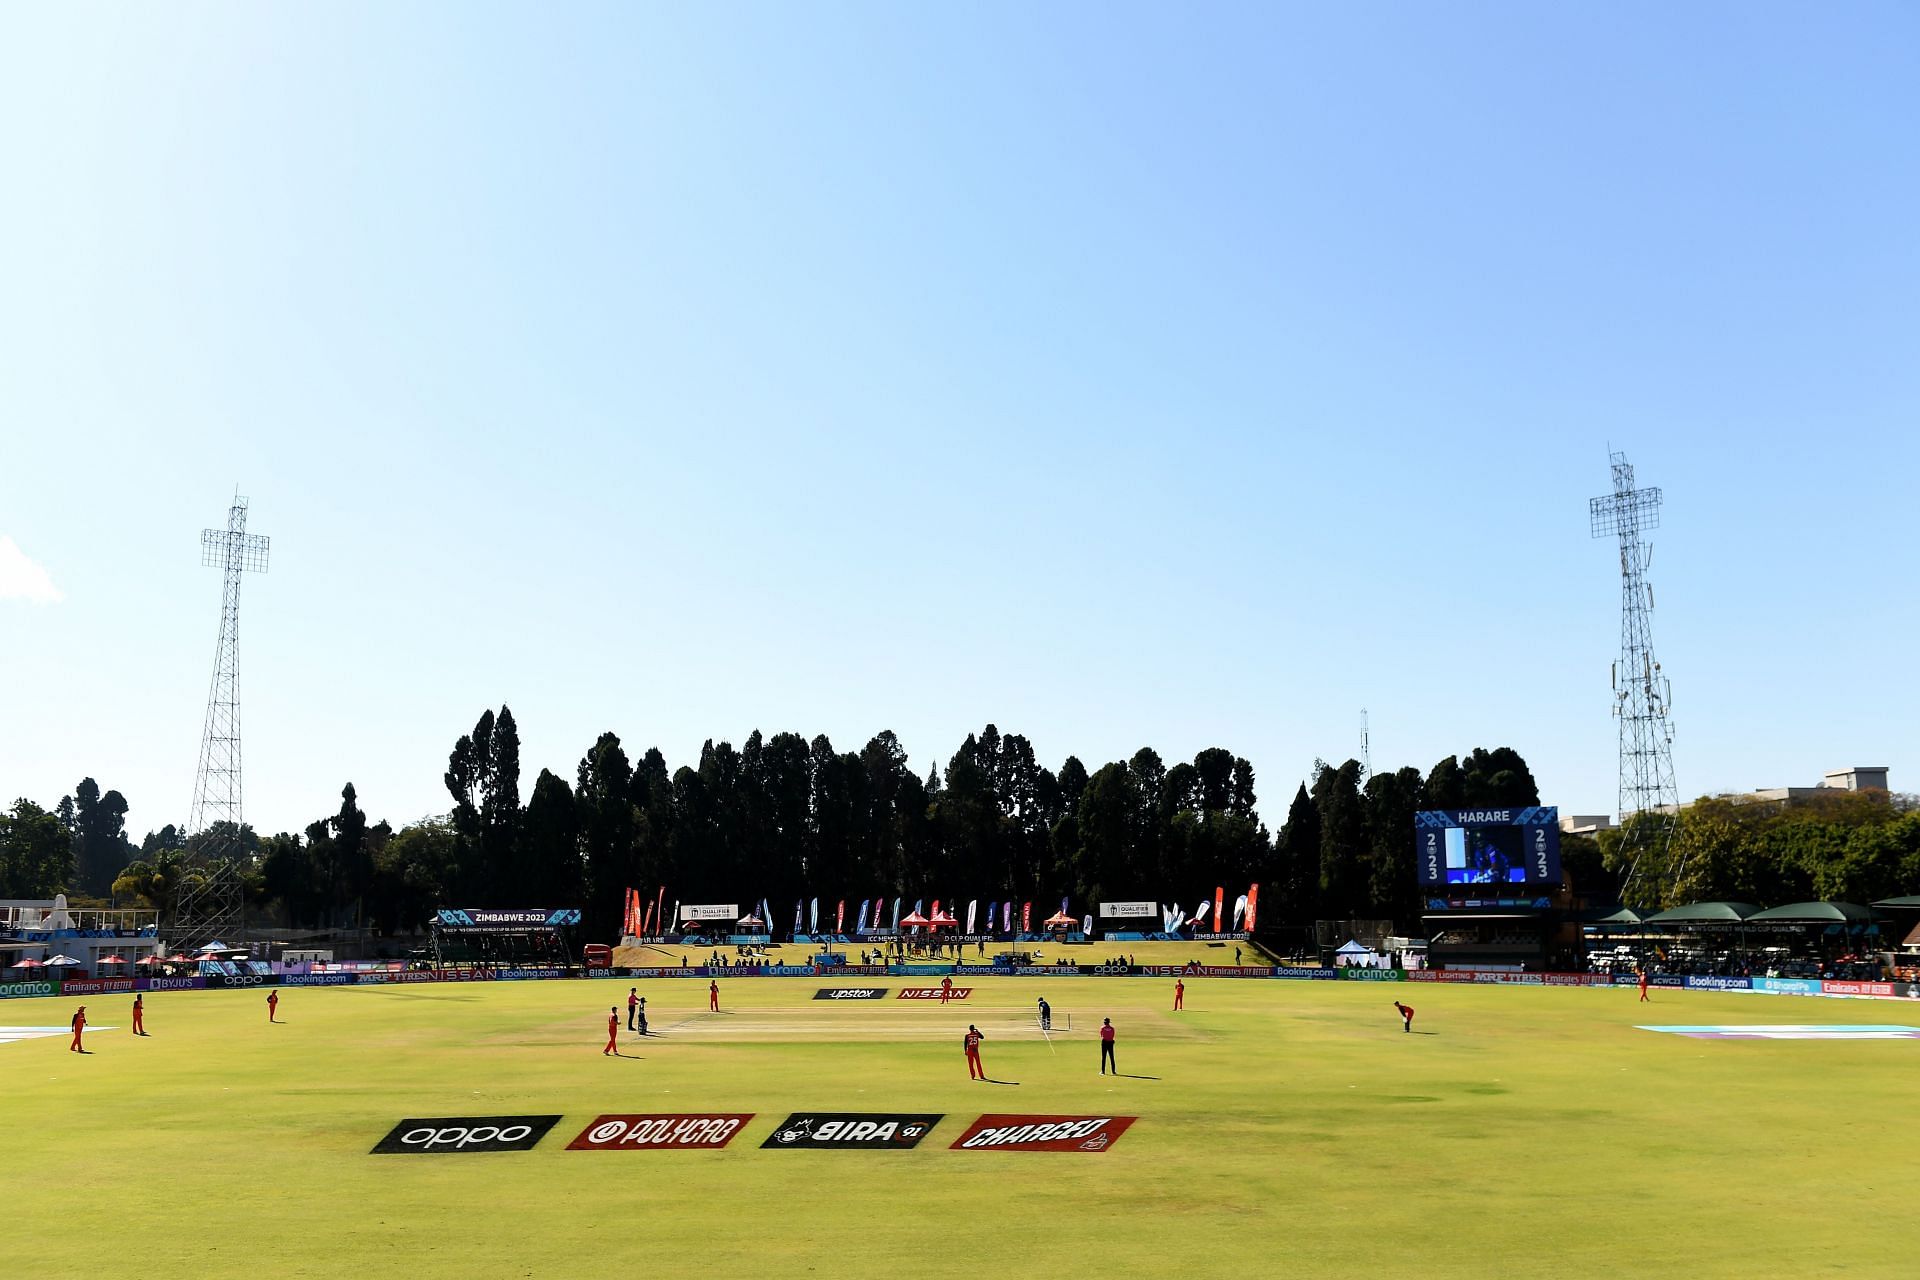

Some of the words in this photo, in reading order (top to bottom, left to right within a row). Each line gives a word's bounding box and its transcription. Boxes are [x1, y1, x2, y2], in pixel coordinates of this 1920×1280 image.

[1458, 811, 1510, 823] HARARE
[476, 914, 524, 922] ZIMBABWE
[525, 913, 546, 921] 2023
[501, 969, 559, 979] Booking.com
[588, 968, 610, 977] BIRA
[630, 968, 662, 976] MRF
[664, 968, 695, 976] TYRES
[720, 967, 748, 975] BYJU'S
[769, 965, 815, 975] aramco
[827, 966, 859, 974] Emirates
[907, 966, 940, 974] BharatPe
[956, 965, 1010, 974] Booking.com
[1016, 966, 1048, 974] MRF
[1048, 966, 1079, 974] TYRES
[1094, 965, 1128, 975] oppo
[1142, 966, 1207, 975] NISSAN
[1209, 967, 1242, 975] Emirates
[1252, 967, 1270, 976] BETTER
[1277, 967, 1333, 977] Booking.com
[1348, 969, 1398, 979] aramco
[285, 974, 346, 984] Booking.com
[359, 973, 394, 982] MRF
[394, 972, 427, 981] TYRES
[427, 970, 497, 980] NISSAN
[1473, 972, 1507, 981] MRF
[1508, 973, 1543, 982] TYRES
[1545, 974, 1579, 984] Emirates
[161, 978, 193, 989] BYJU'S
[224, 975, 263, 986] oppo
[1652, 977, 1681, 985] #CWC23
[1689, 976, 1748, 988] Booking.com
[1773, 980, 1810, 991] BharatPe
[0, 983, 51, 995] aramco
[64, 983, 101, 992] Emirates
[103, 981, 113, 990] FLY
[113, 981, 133, 990] BETTER
[1823, 982, 1860, 993] Emirates
[829, 989, 874, 1000] upstox
[620, 1118, 741, 1144] POLYCAB
[811, 1121, 899, 1141] BIRA
[901, 1126, 922, 1138] 91
[962, 1118, 1112, 1148] CHARGED
[400, 1125, 532, 1149] oppo
